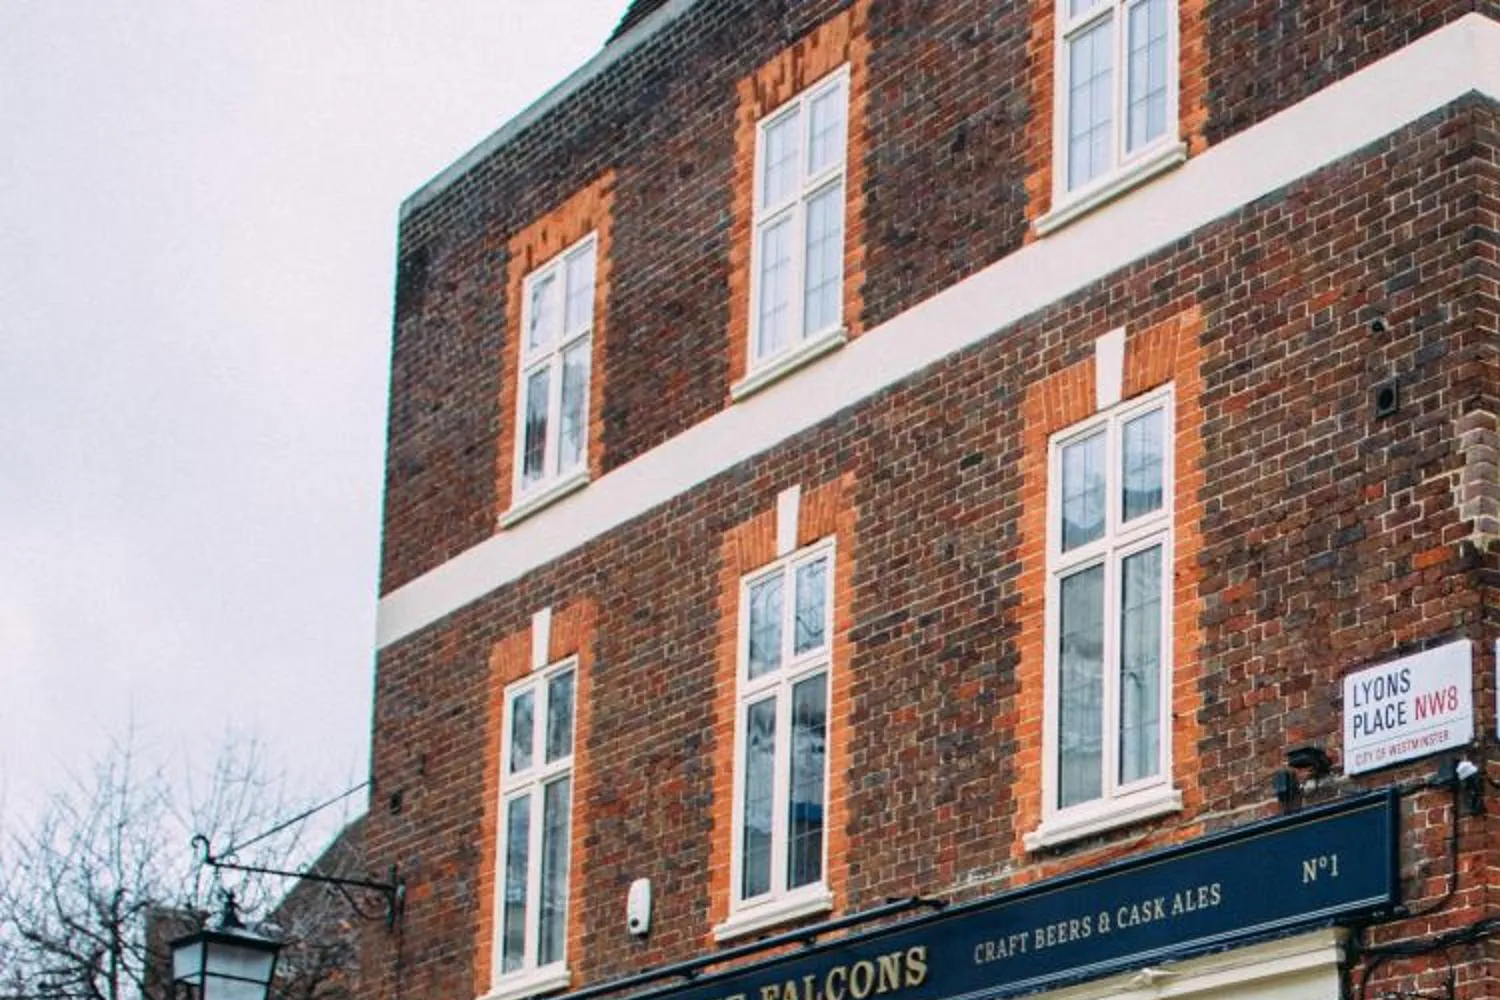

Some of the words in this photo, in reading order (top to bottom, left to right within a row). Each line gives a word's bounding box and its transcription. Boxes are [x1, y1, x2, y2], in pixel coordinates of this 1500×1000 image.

[1353, 667, 1411, 708] LYONS
[1353, 701, 1407, 739] PLACE
[1415, 685, 1458, 721] NW8
[1355, 752, 1374, 766] CITY
[1389, 730, 1450, 756] WESTMINSTER
[974, 931, 1030, 966] CRAFT
[1034, 916, 1092, 950] BEERS
[1097, 914, 1111, 933] &
[1116, 897, 1166, 930] CASK
[1170, 883, 1222, 916] ALES
